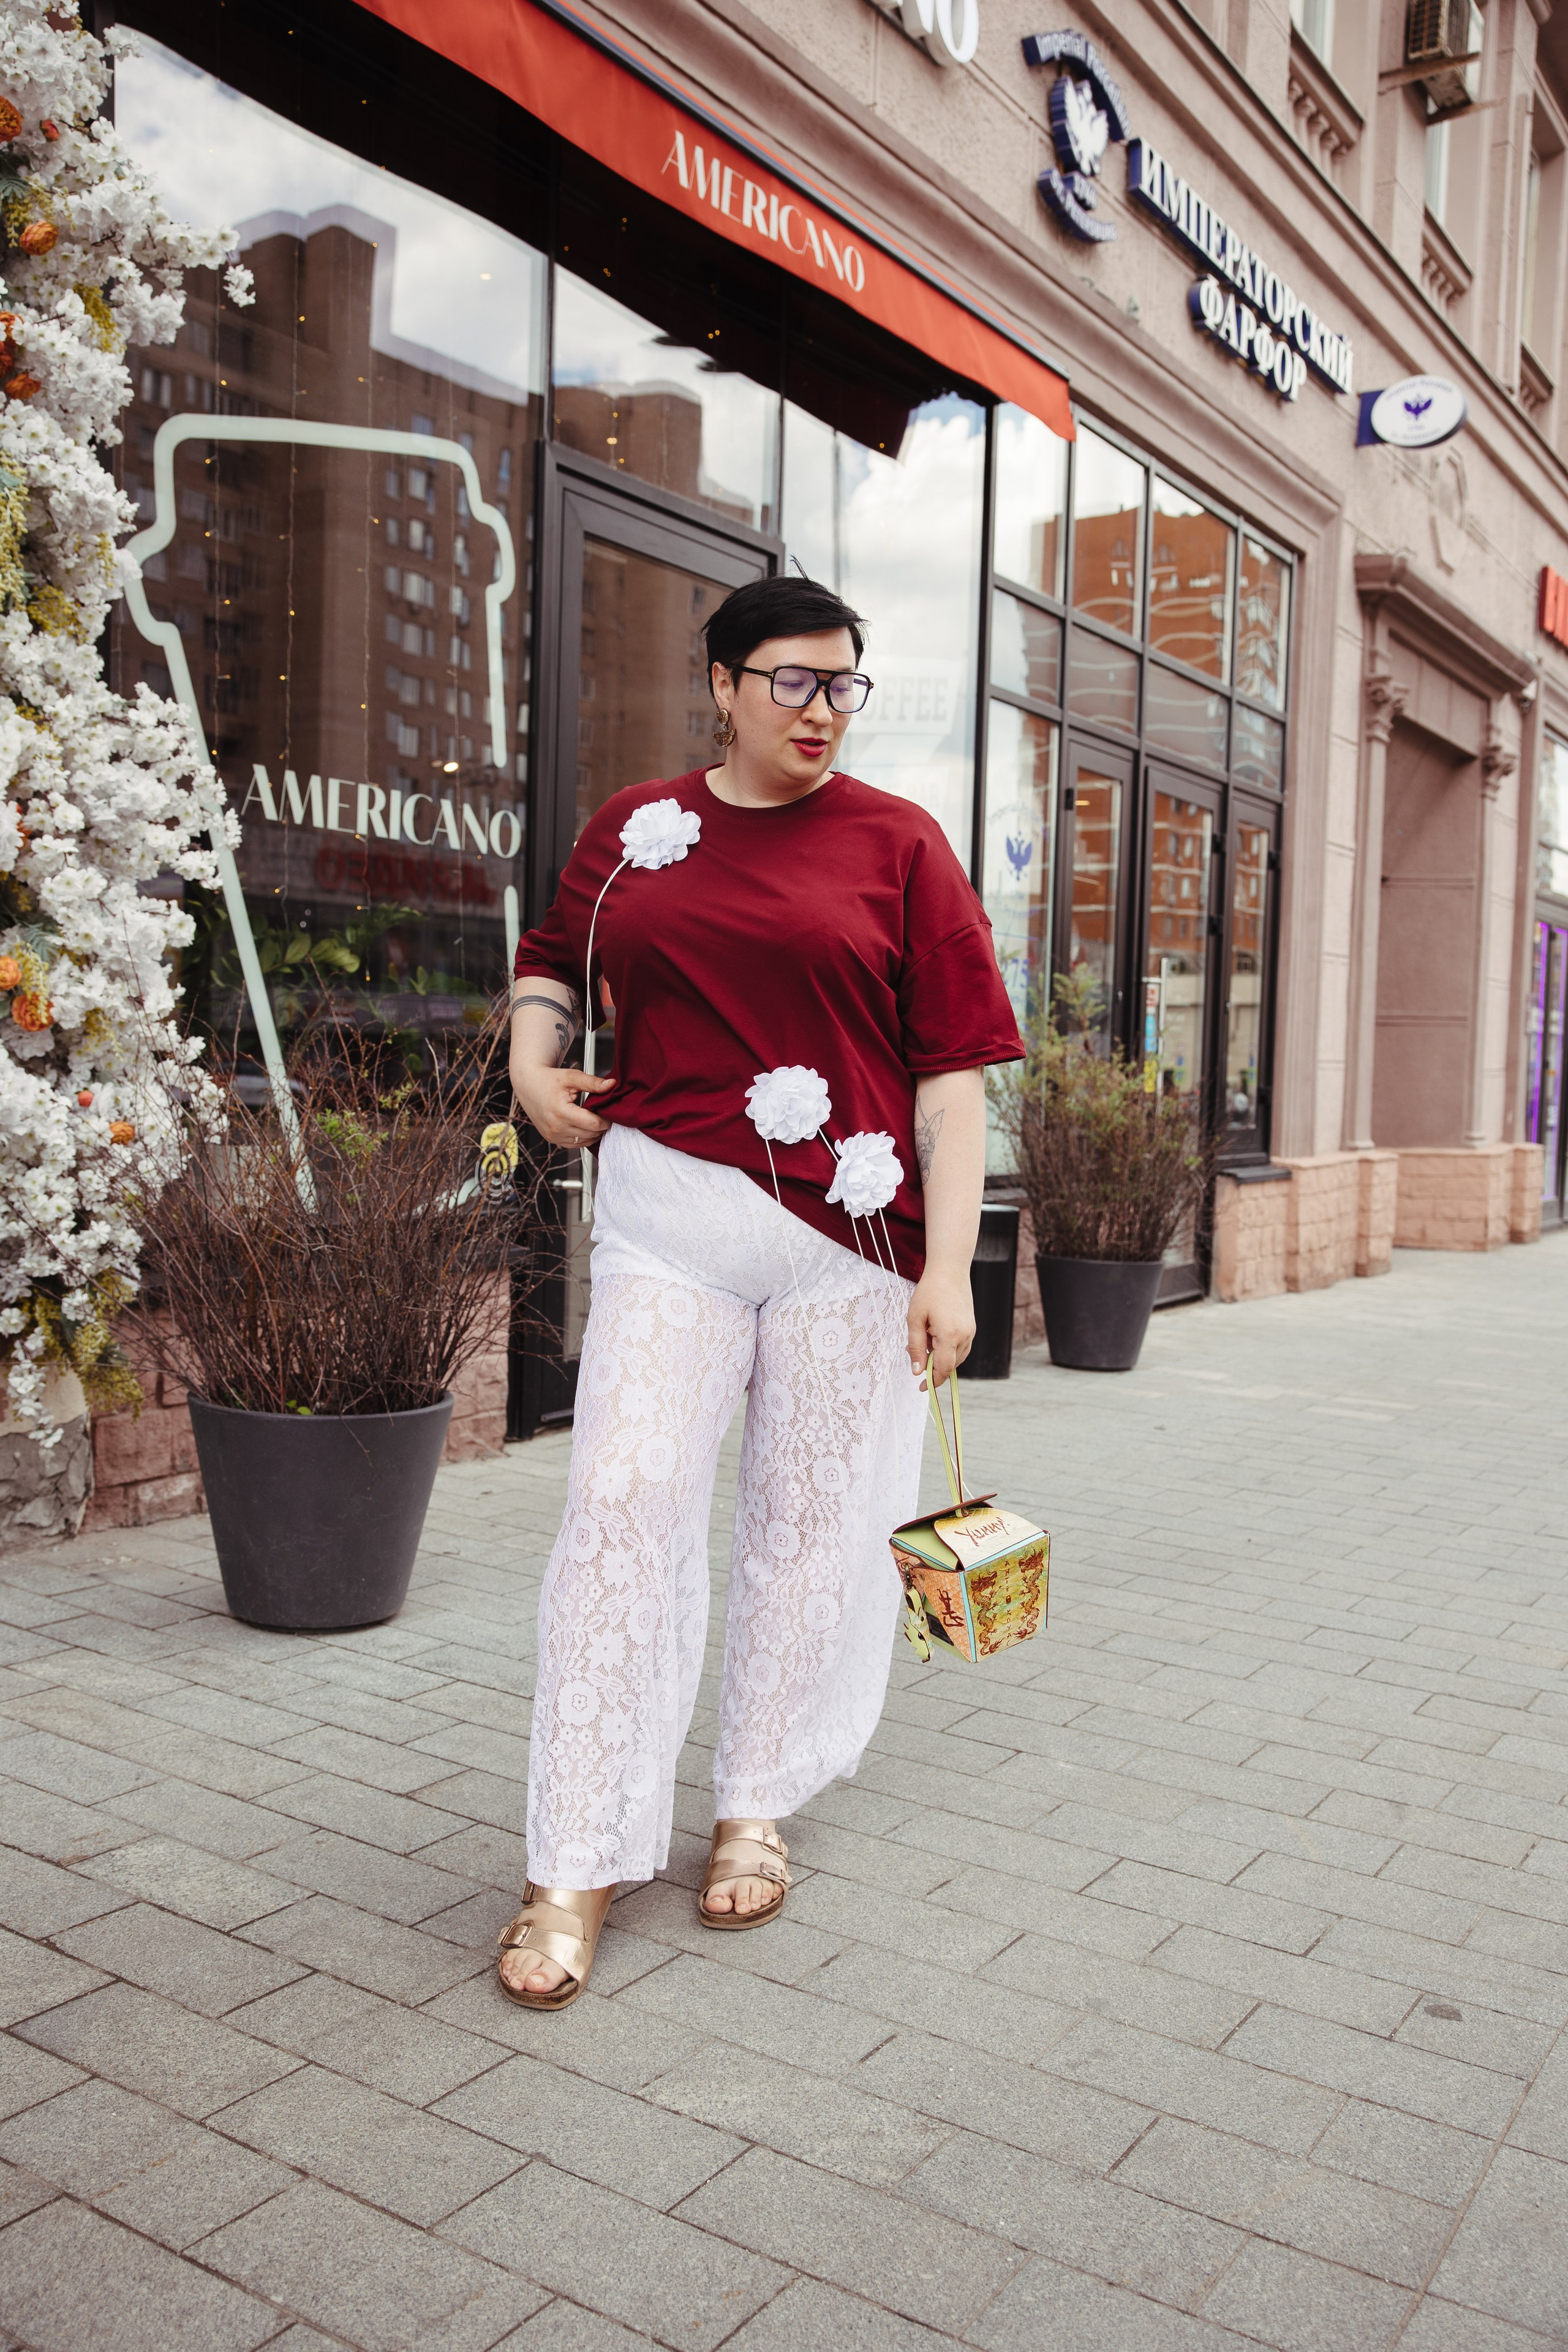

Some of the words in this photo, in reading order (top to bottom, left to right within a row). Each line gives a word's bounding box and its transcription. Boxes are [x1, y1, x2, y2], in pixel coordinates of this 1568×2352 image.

[1036, 29, 1086, 62] Imperial
[661, 129, 865, 292] AMERICANO
[1139, 137, 1354, 395] ИМПЕРАТОРСКИЙ
[1200, 273, 1308, 404] ФАРФОР
[858, 676, 948, 722] OFFEE
[241, 763, 522, 859] AMERICANO
